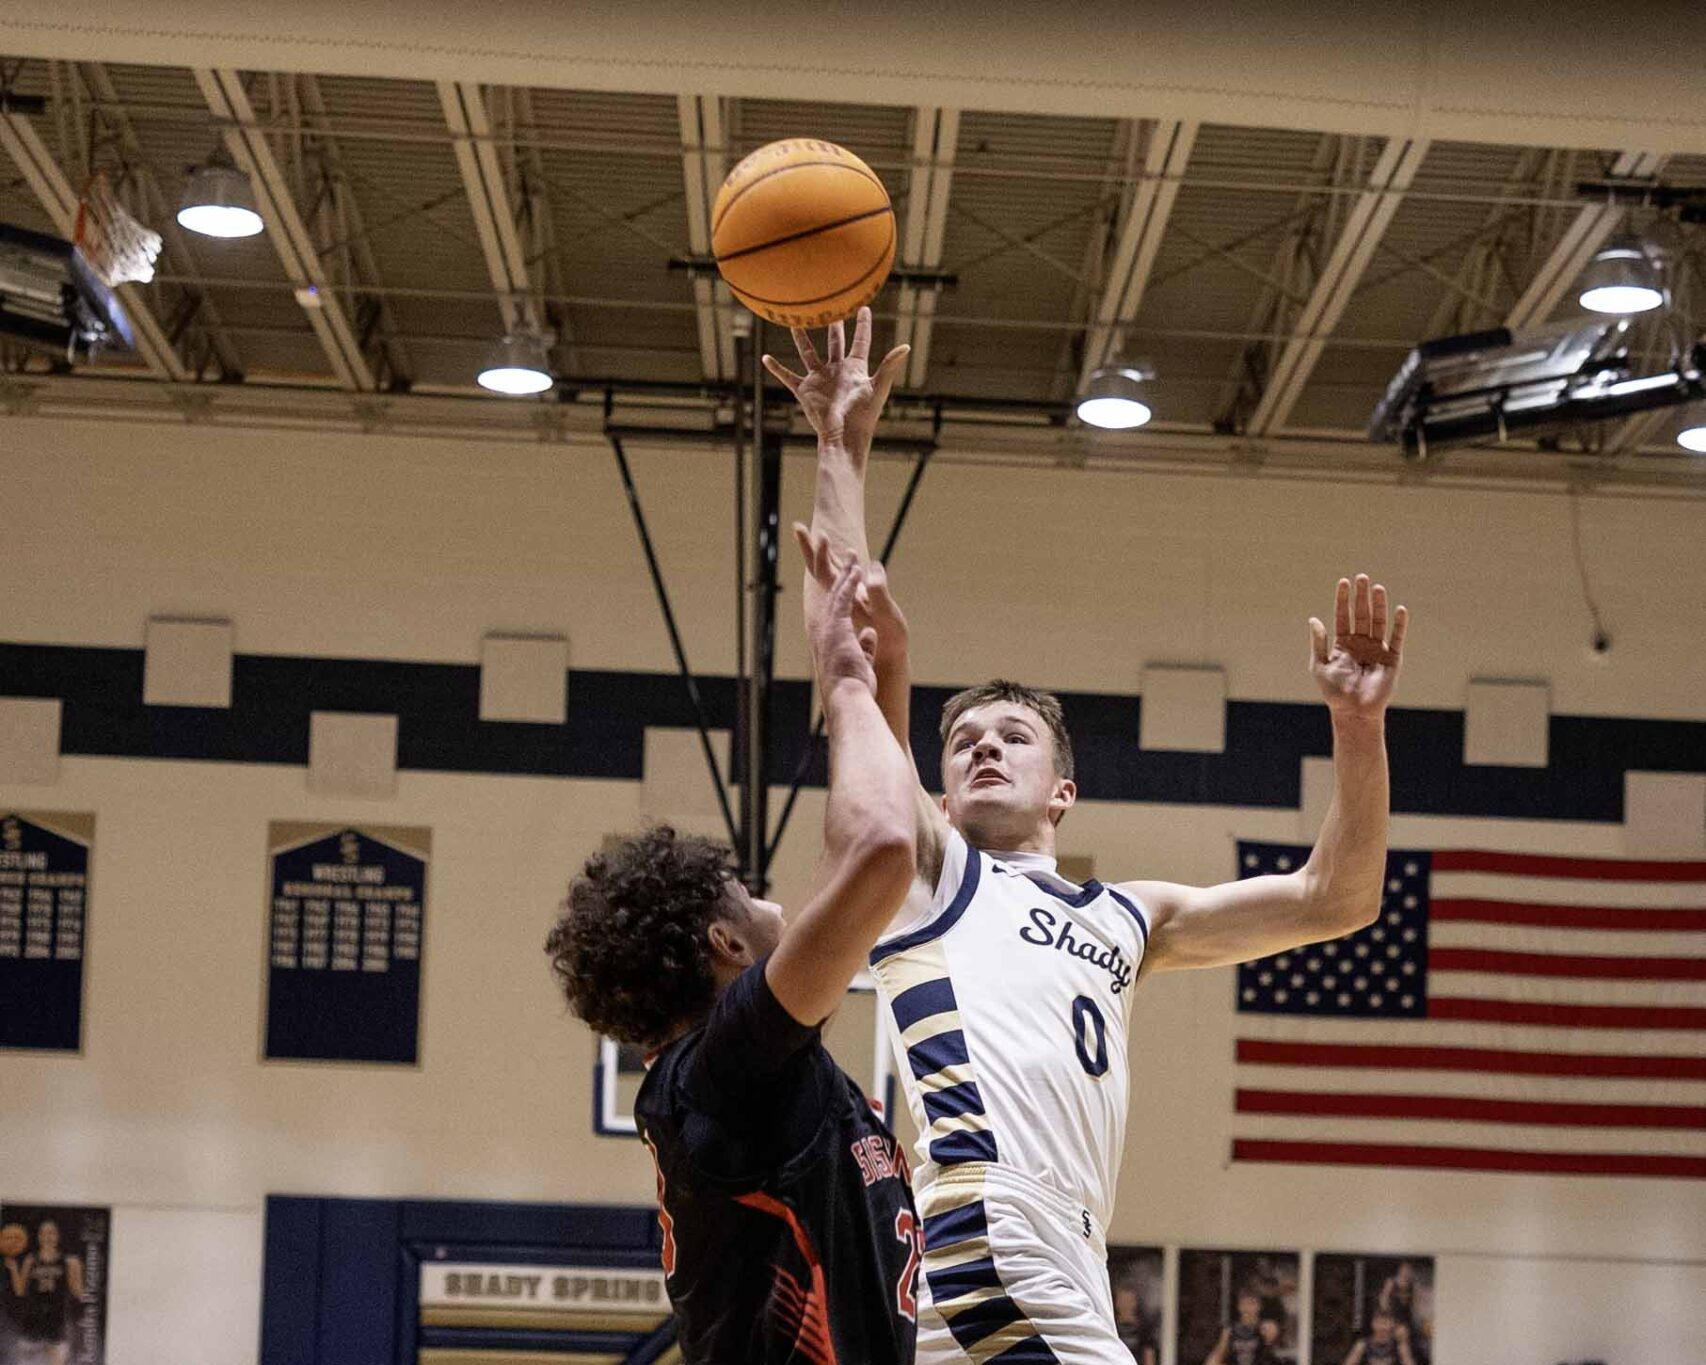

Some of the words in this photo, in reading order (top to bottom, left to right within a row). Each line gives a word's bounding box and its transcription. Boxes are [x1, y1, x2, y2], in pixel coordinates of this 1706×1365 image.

[312, 863, 385, 884] WRESTLING
[1019, 907, 1132, 995] Shady
[1072, 995, 1109, 1077] 0
[444, 1271, 541, 1299] SHADY
[552, 1276, 661, 1303] SPRING
[895, 1207, 925, 1324] 2
